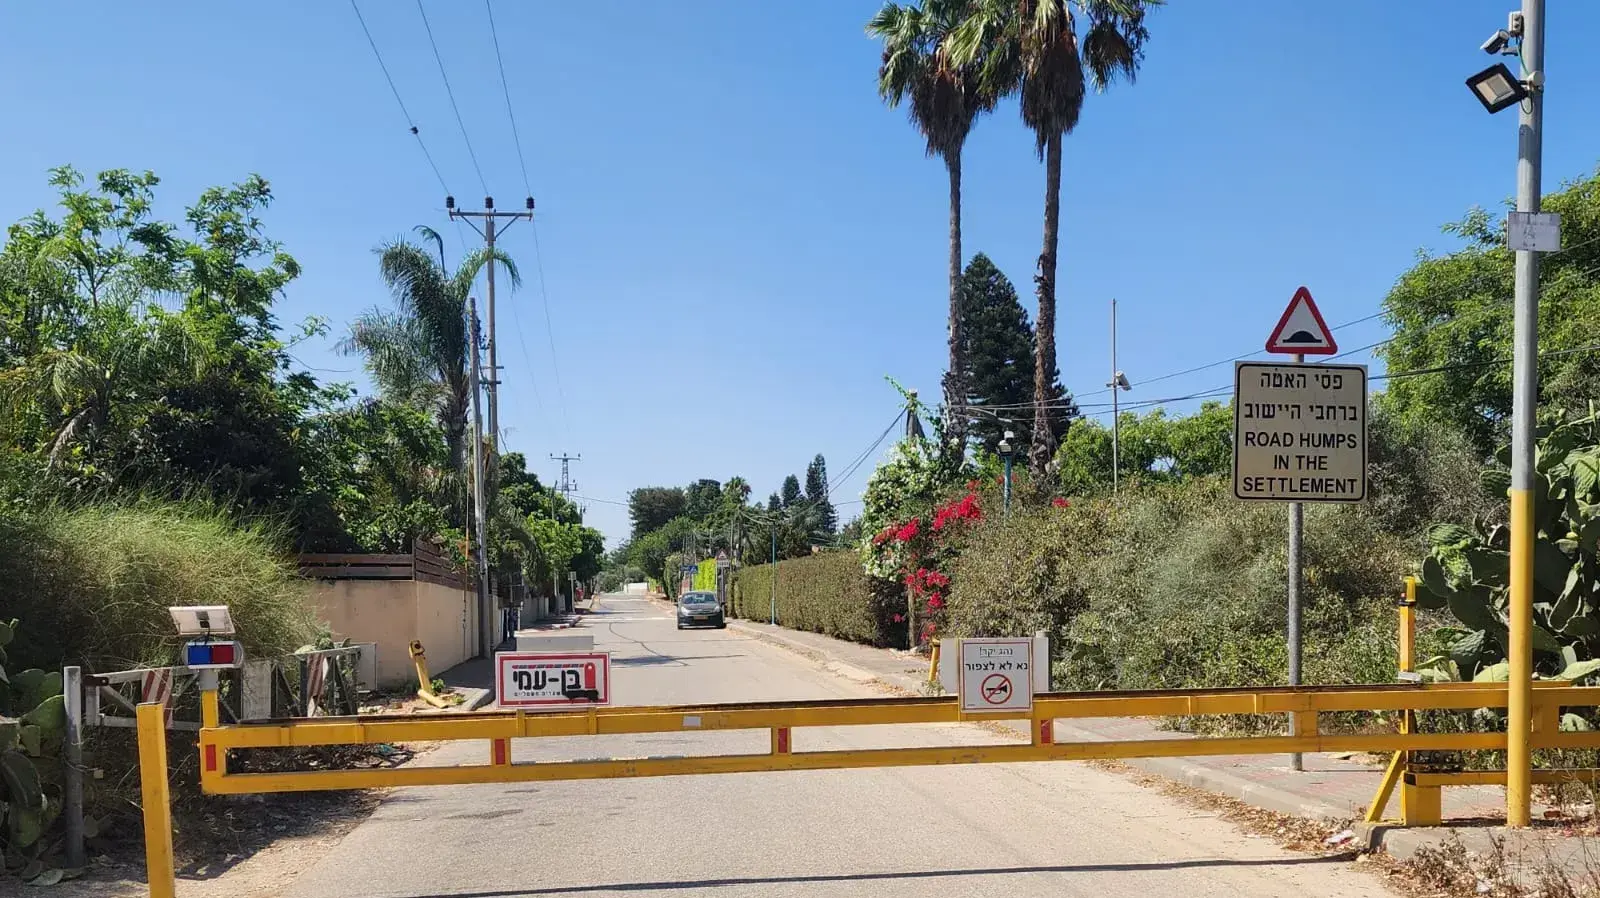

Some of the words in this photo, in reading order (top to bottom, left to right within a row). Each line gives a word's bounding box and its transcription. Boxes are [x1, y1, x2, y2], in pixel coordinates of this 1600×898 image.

[1260, 372, 1307, 389] האטה
[1314, 373, 1343, 390] פסי
[1244, 402, 1301, 420] היישוב
[1309, 404, 1358, 421] ברחבי
[1244, 431, 1294, 447] ROAD
[1299, 432, 1358, 449] HUMPS
[1273, 454, 1289, 470] IN
[1295, 455, 1328, 471] THE
[1242, 476, 1358, 494] SETTLEMENT
[999, 647, 1013, 656] נהג
[965, 660, 996, 671] לצפור
[999, 660, 1013, 671] לא
[1016, 662, 1028, 670] נא
[512, 669, 582, 696] בן-עמי
